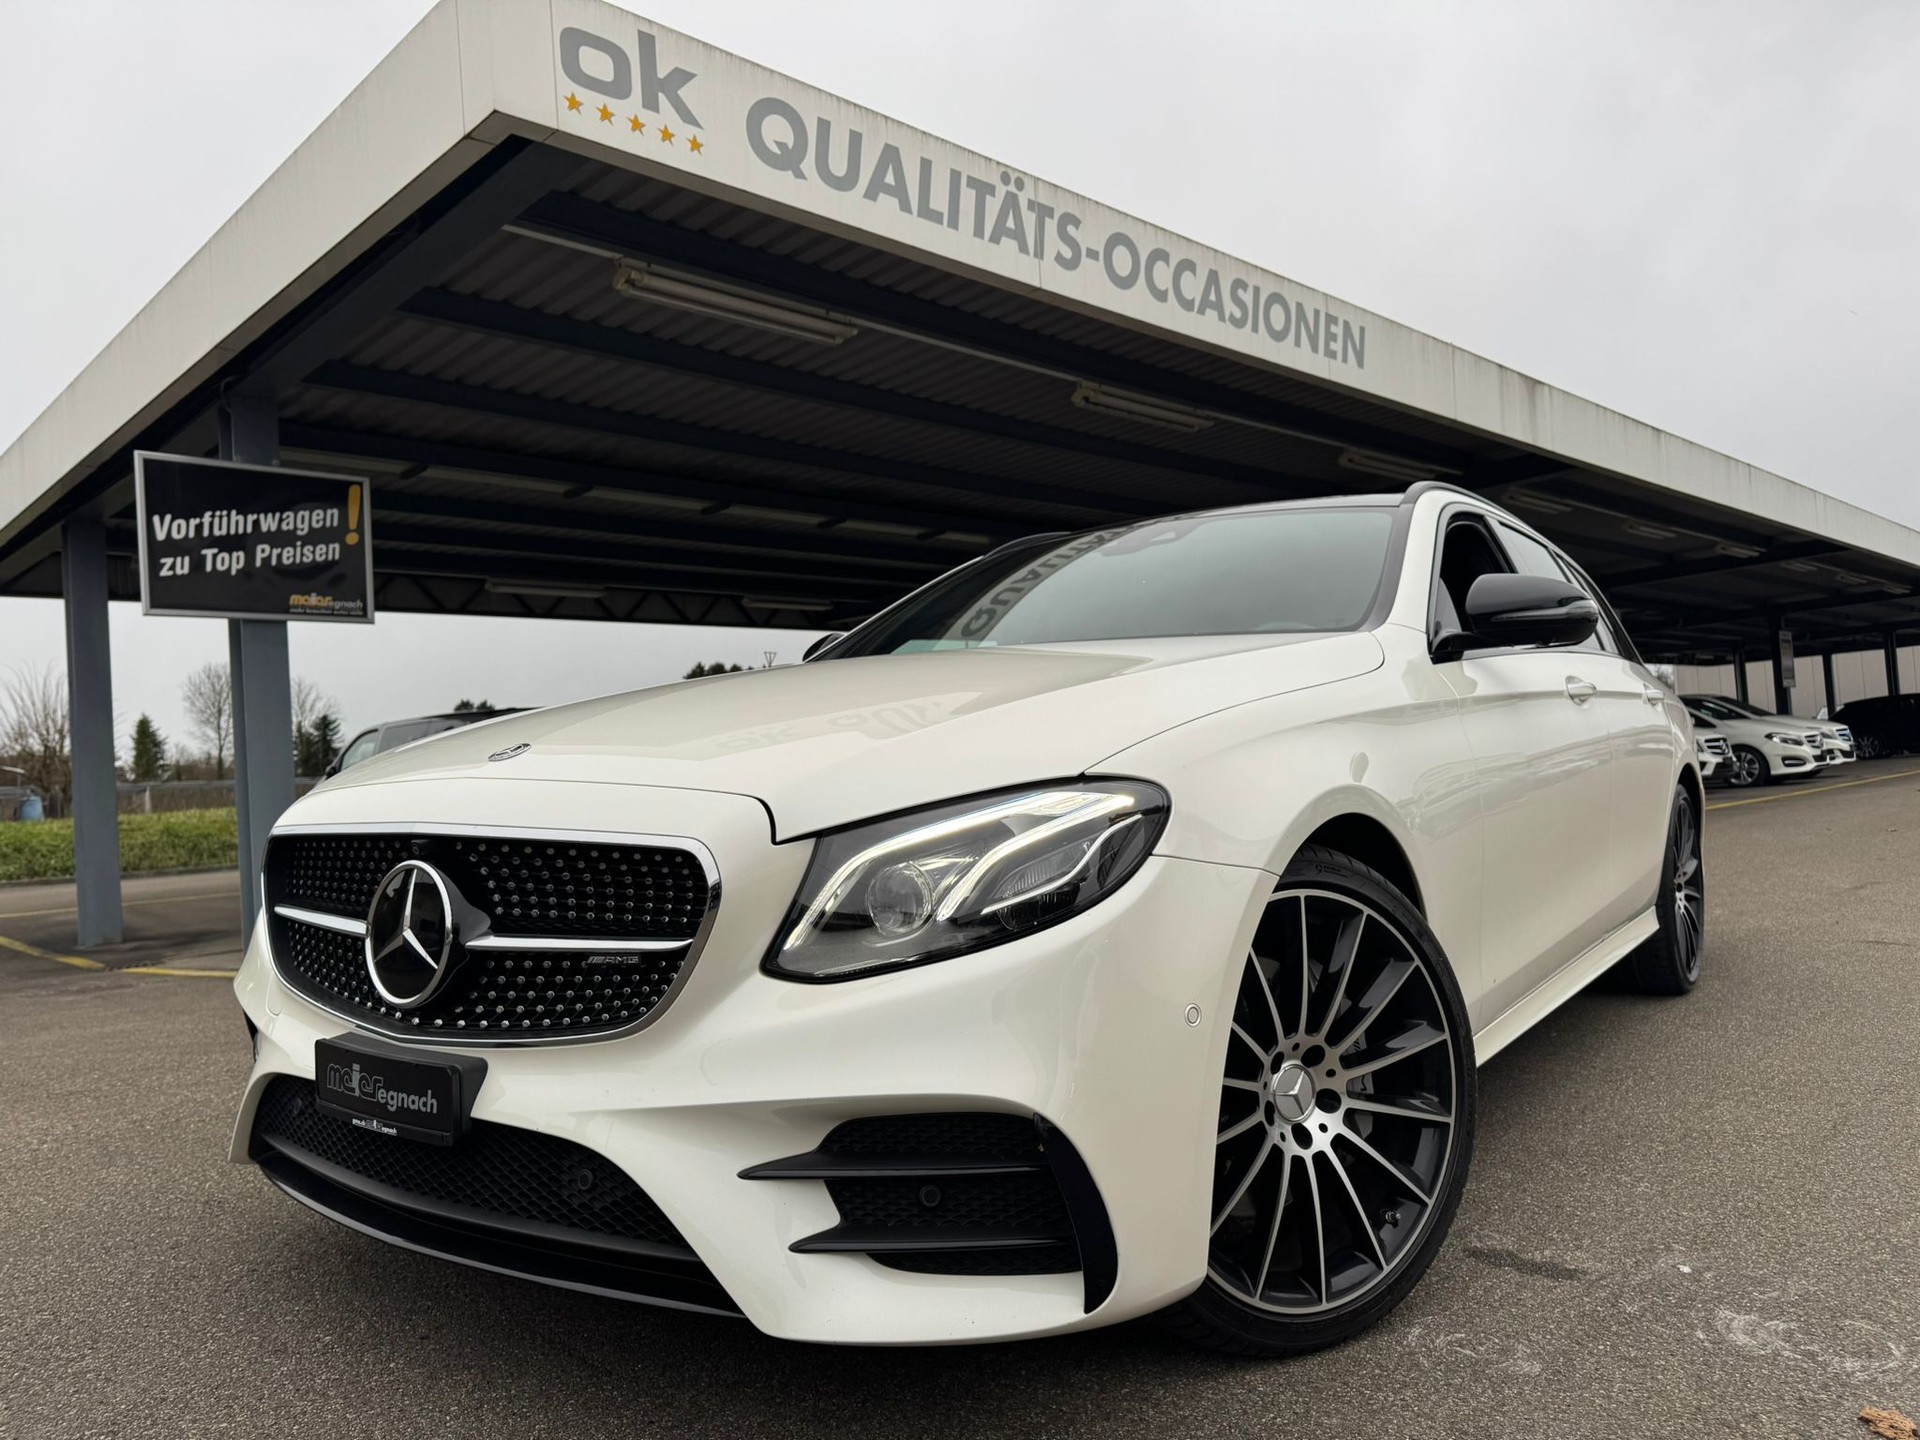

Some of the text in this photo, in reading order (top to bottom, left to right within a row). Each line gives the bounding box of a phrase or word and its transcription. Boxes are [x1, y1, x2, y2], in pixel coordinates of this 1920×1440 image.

[559, 26, 704, 130] ok
[746, 97, 1365, 370] QUALITÄTS-OCCASIONEN
[152, 507, 339, 542] Vorführwagen
[159, 541, 340, 577] zu Top Preisen
